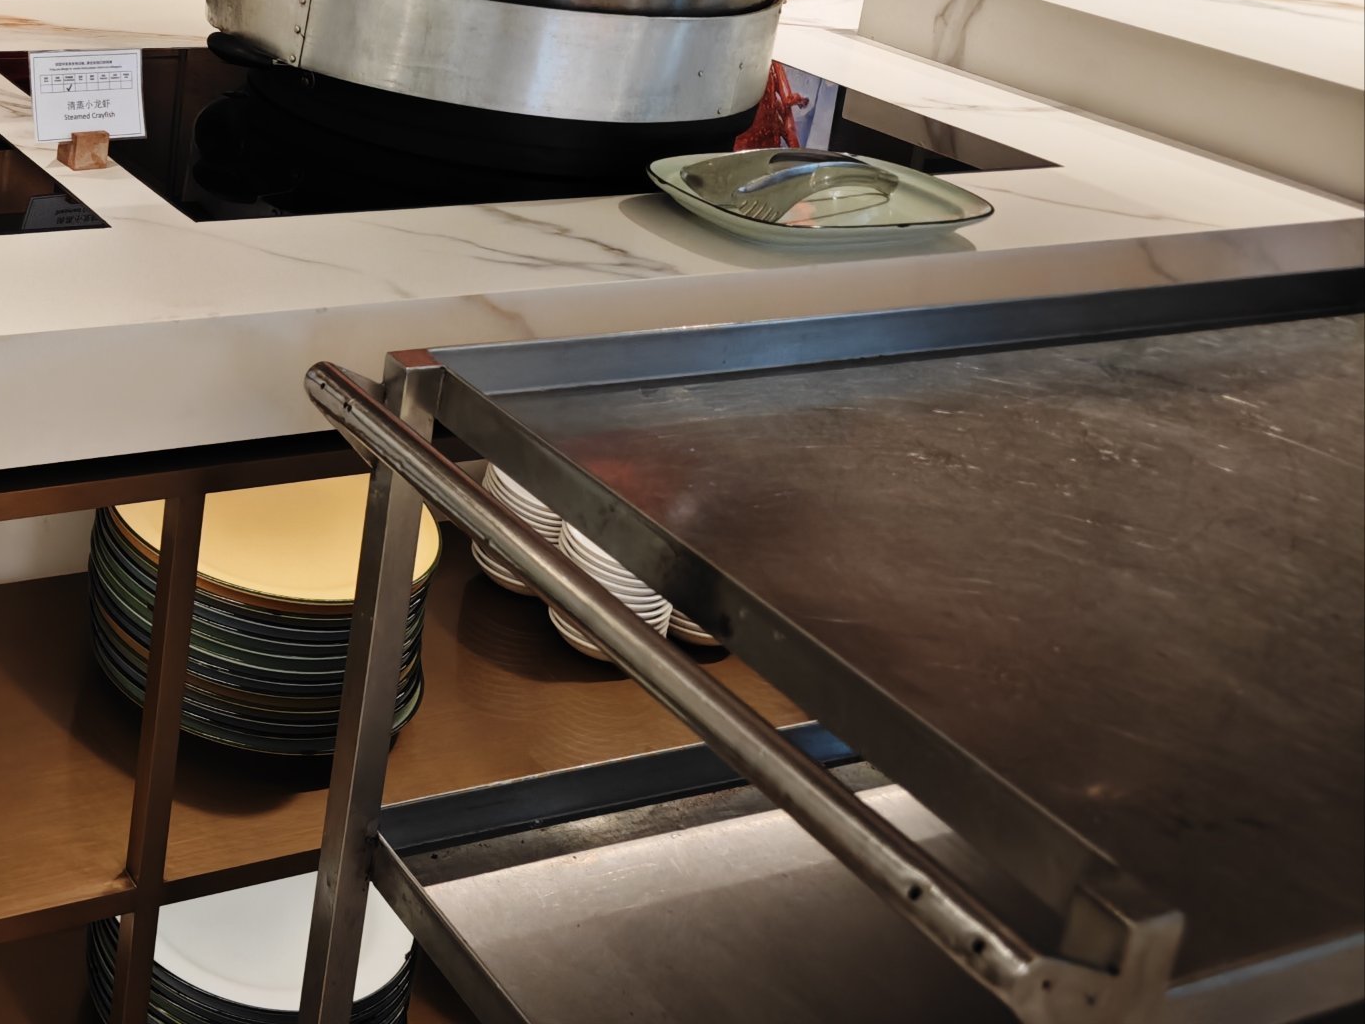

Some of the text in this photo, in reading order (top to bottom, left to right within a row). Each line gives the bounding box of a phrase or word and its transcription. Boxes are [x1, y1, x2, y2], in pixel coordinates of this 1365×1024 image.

[67, 99, 110, 111] 清蒸小龙虾
[64, 111, 115, 121] Steamed Crayfish
